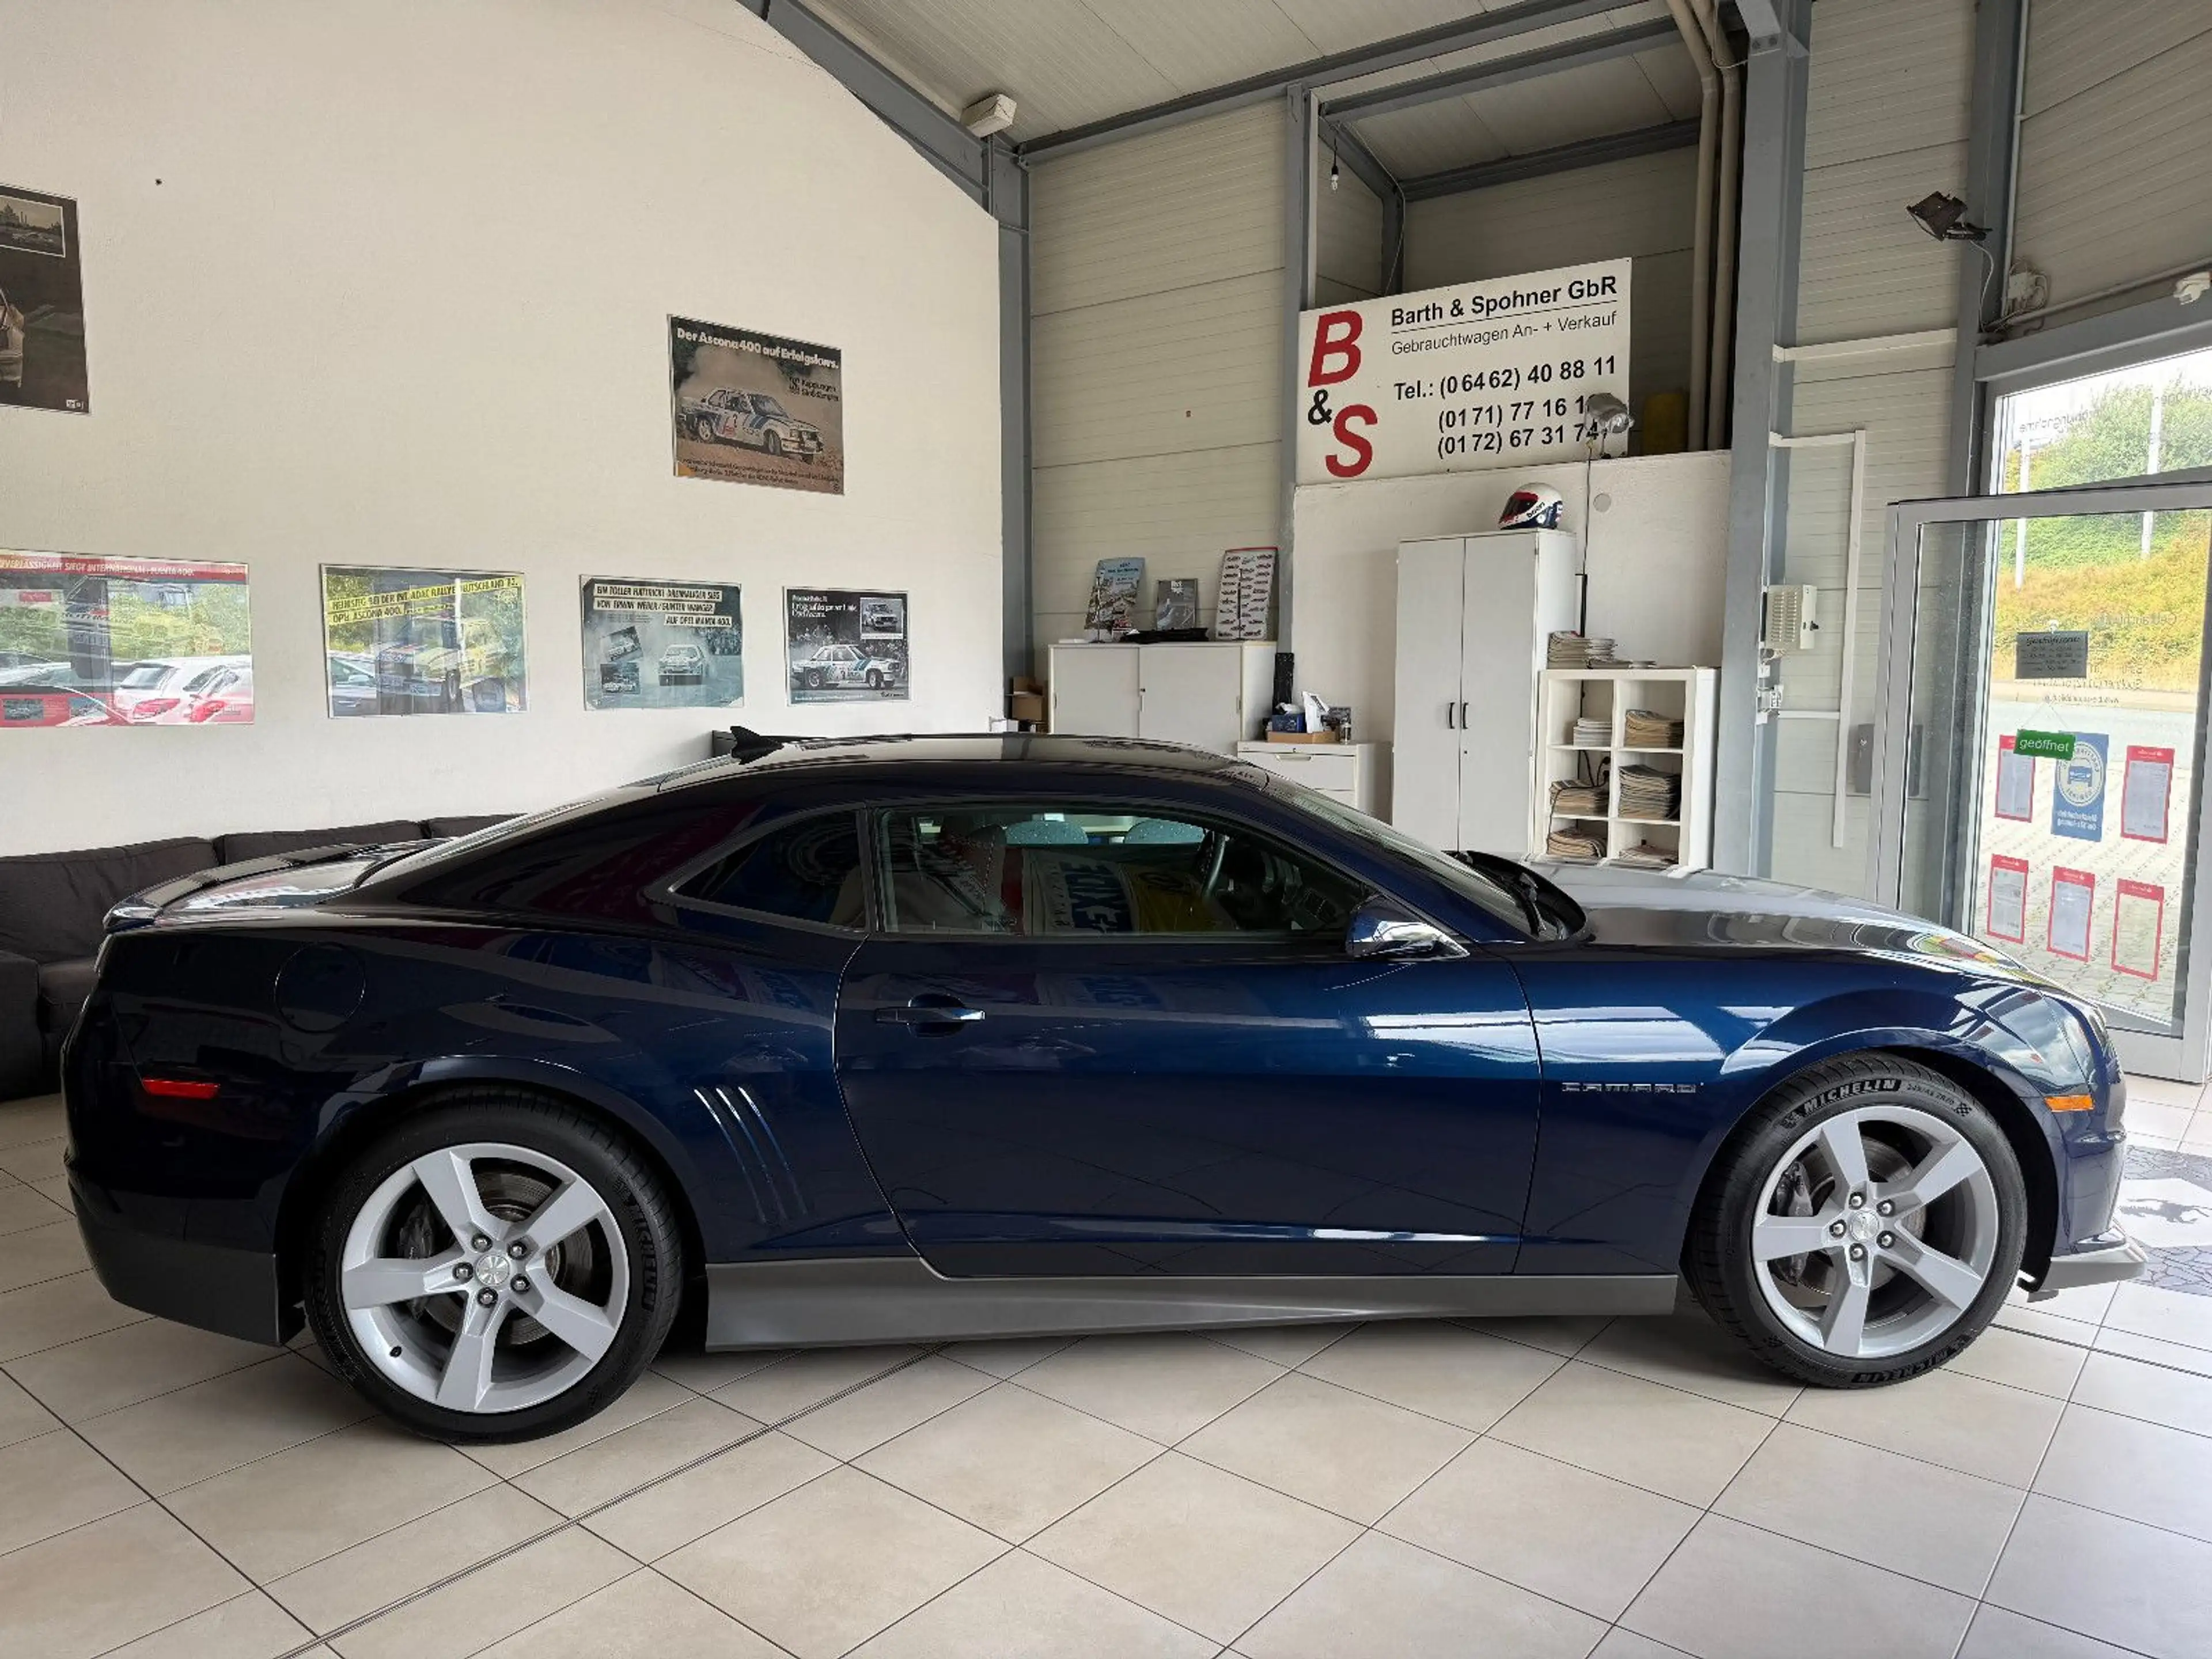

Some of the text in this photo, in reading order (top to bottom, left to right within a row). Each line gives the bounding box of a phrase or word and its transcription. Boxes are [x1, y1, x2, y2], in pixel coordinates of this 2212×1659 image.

[1392, 275, 1618, 327] Barth & Spohner GbR
[677, 327, 698, 342] Der
[1392, 310, 1617, 355] Gebrauchtwagen An- + Verkauf
[1393, 380, 1434, 400] Tel.:
[1527, 363, 1552, 384] 40
[1560, 359, 1585, 380] 88
[1593, 355, 1615, 376] 11
[1307, 309, 1378, 478] B & S
[1510, 400, 1535, 421] 77
[1542, 397, 1567, 417] 16
[1509, 428, 1534, 448] 67
[1541, 425, 1563, 445] 31
[2019, 737, 2070, 752] geöffnet
[1562, 1082, 1696, 1093] CAMARO
[1803, 1078, 1897, 1114] MICHELIN
